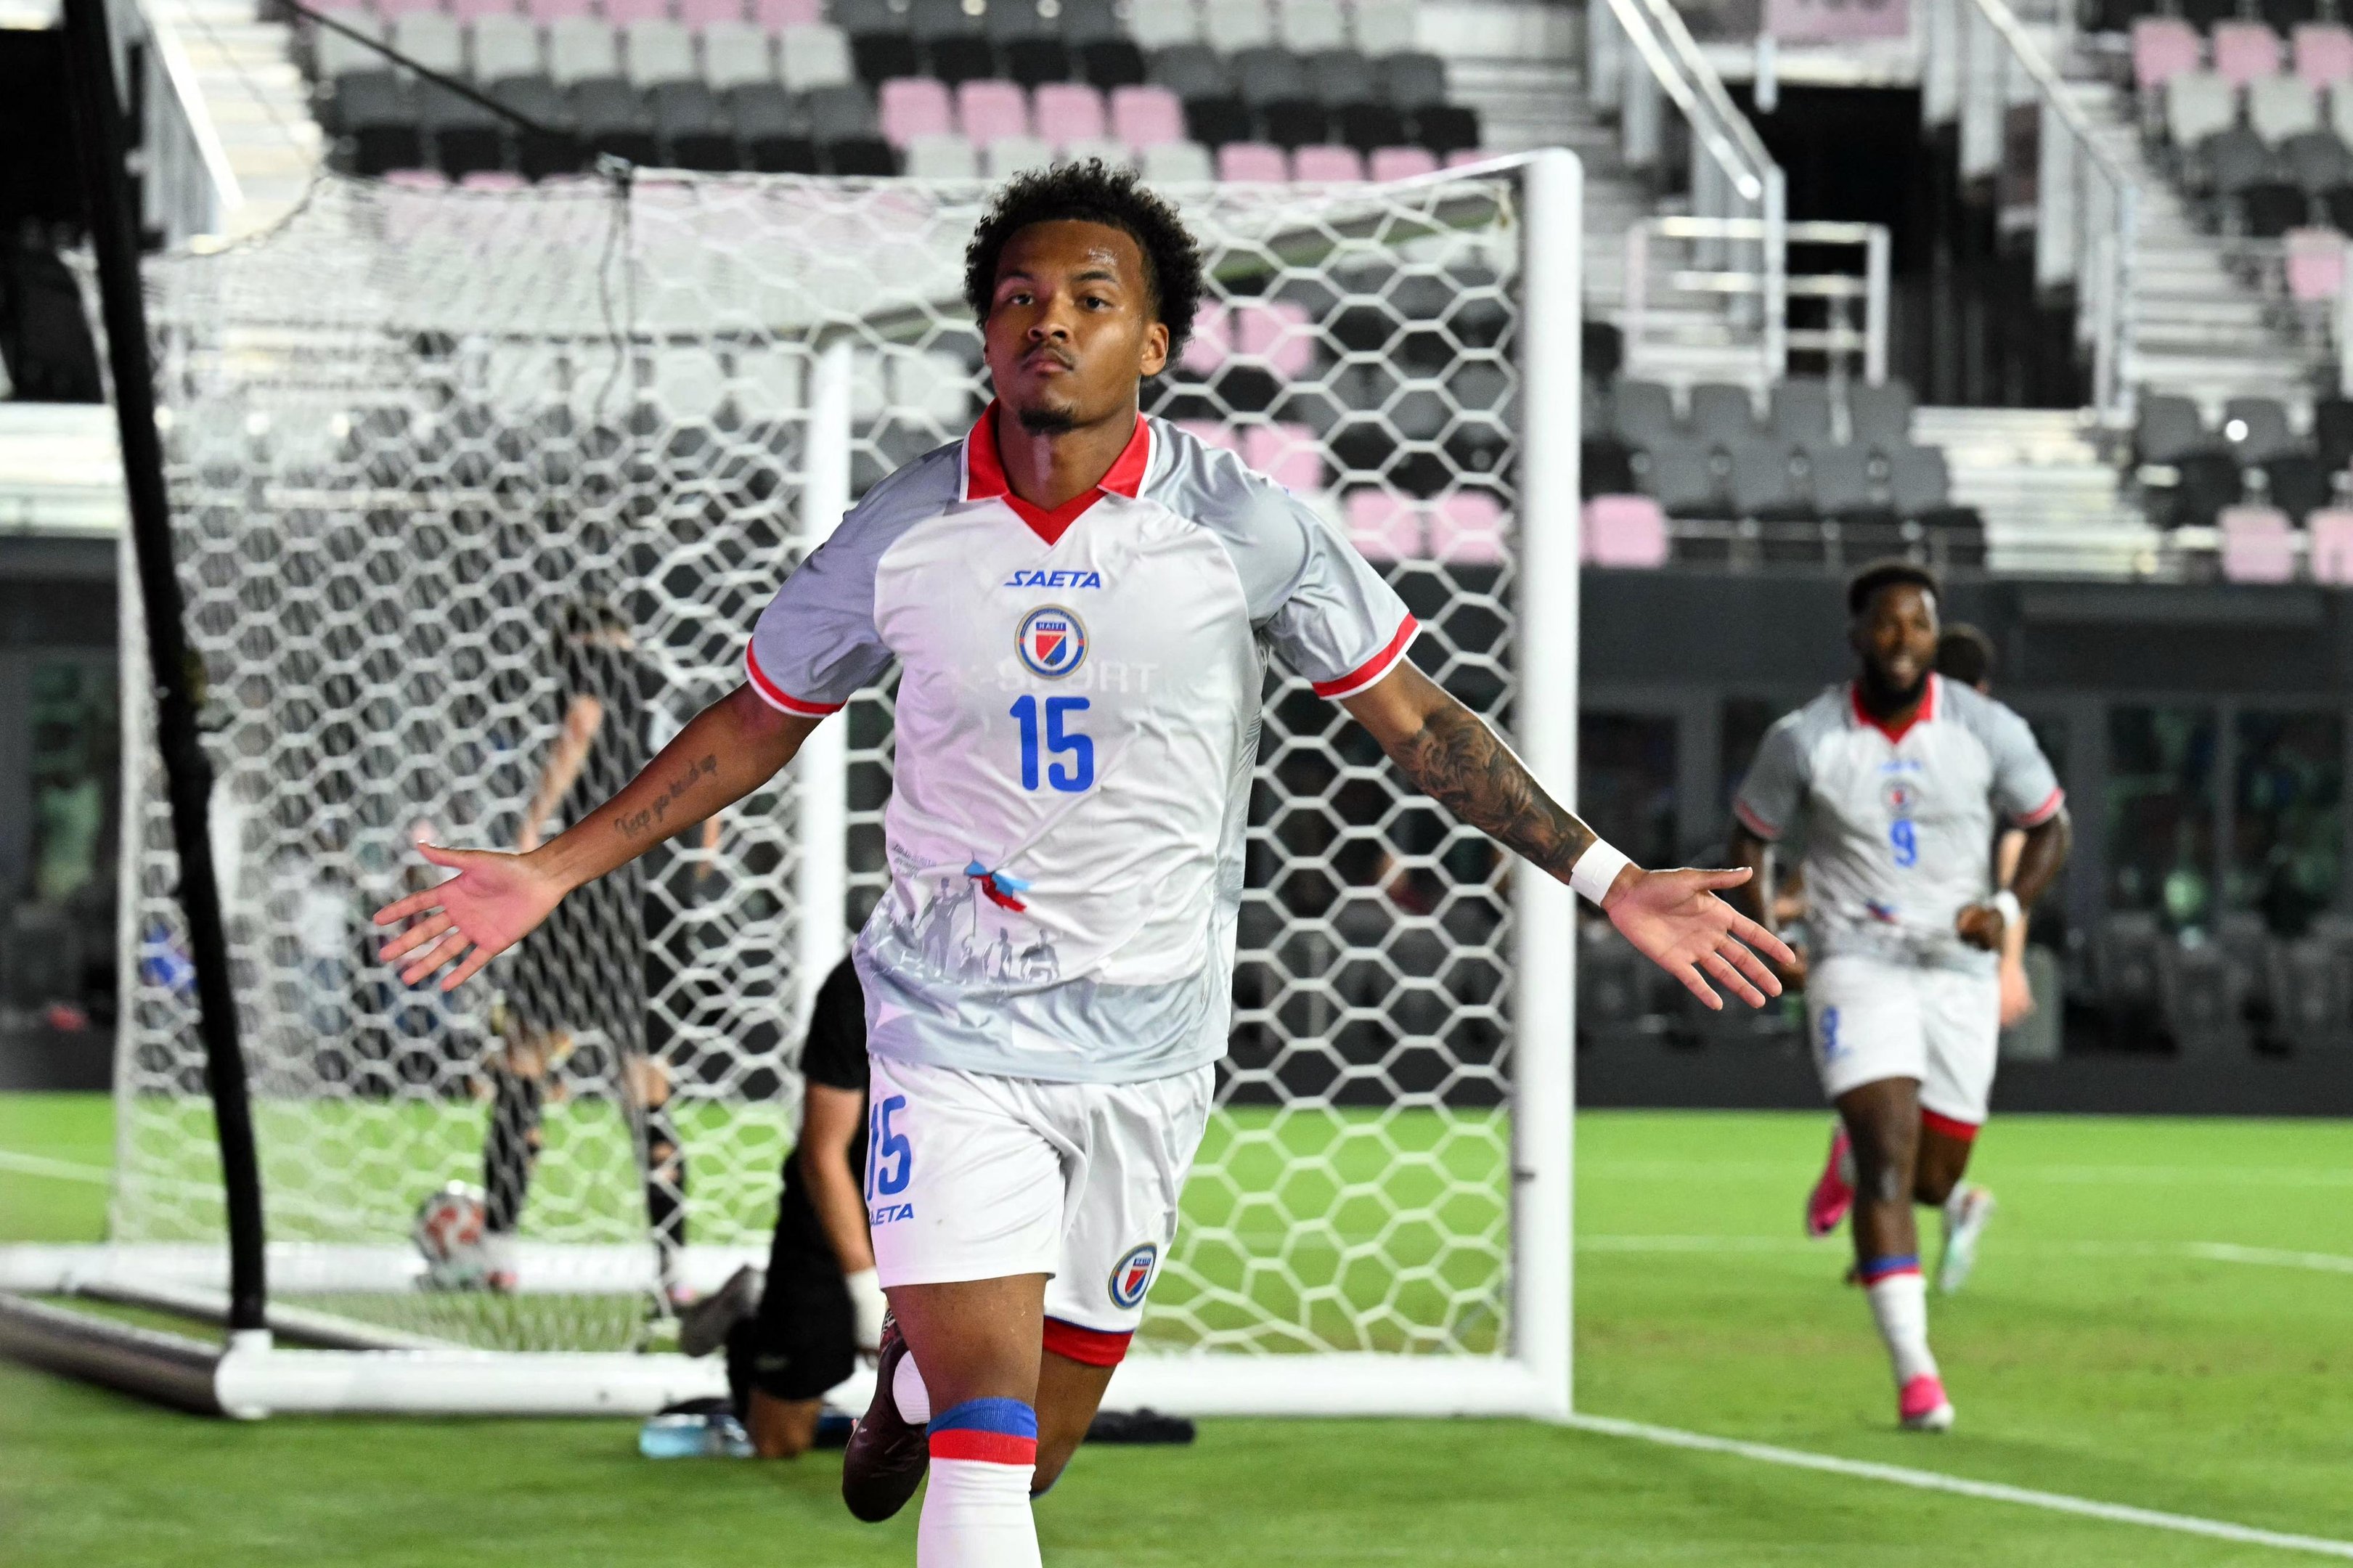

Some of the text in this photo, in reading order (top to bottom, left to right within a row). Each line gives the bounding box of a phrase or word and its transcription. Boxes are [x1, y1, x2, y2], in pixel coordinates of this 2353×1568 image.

[1004, 571, 1101, 589] SAETA
[1010, 695, 1094, 793] 15
[1891, 818, 1917, 867] 9
[869, 1203, 914, 1227] AETA
